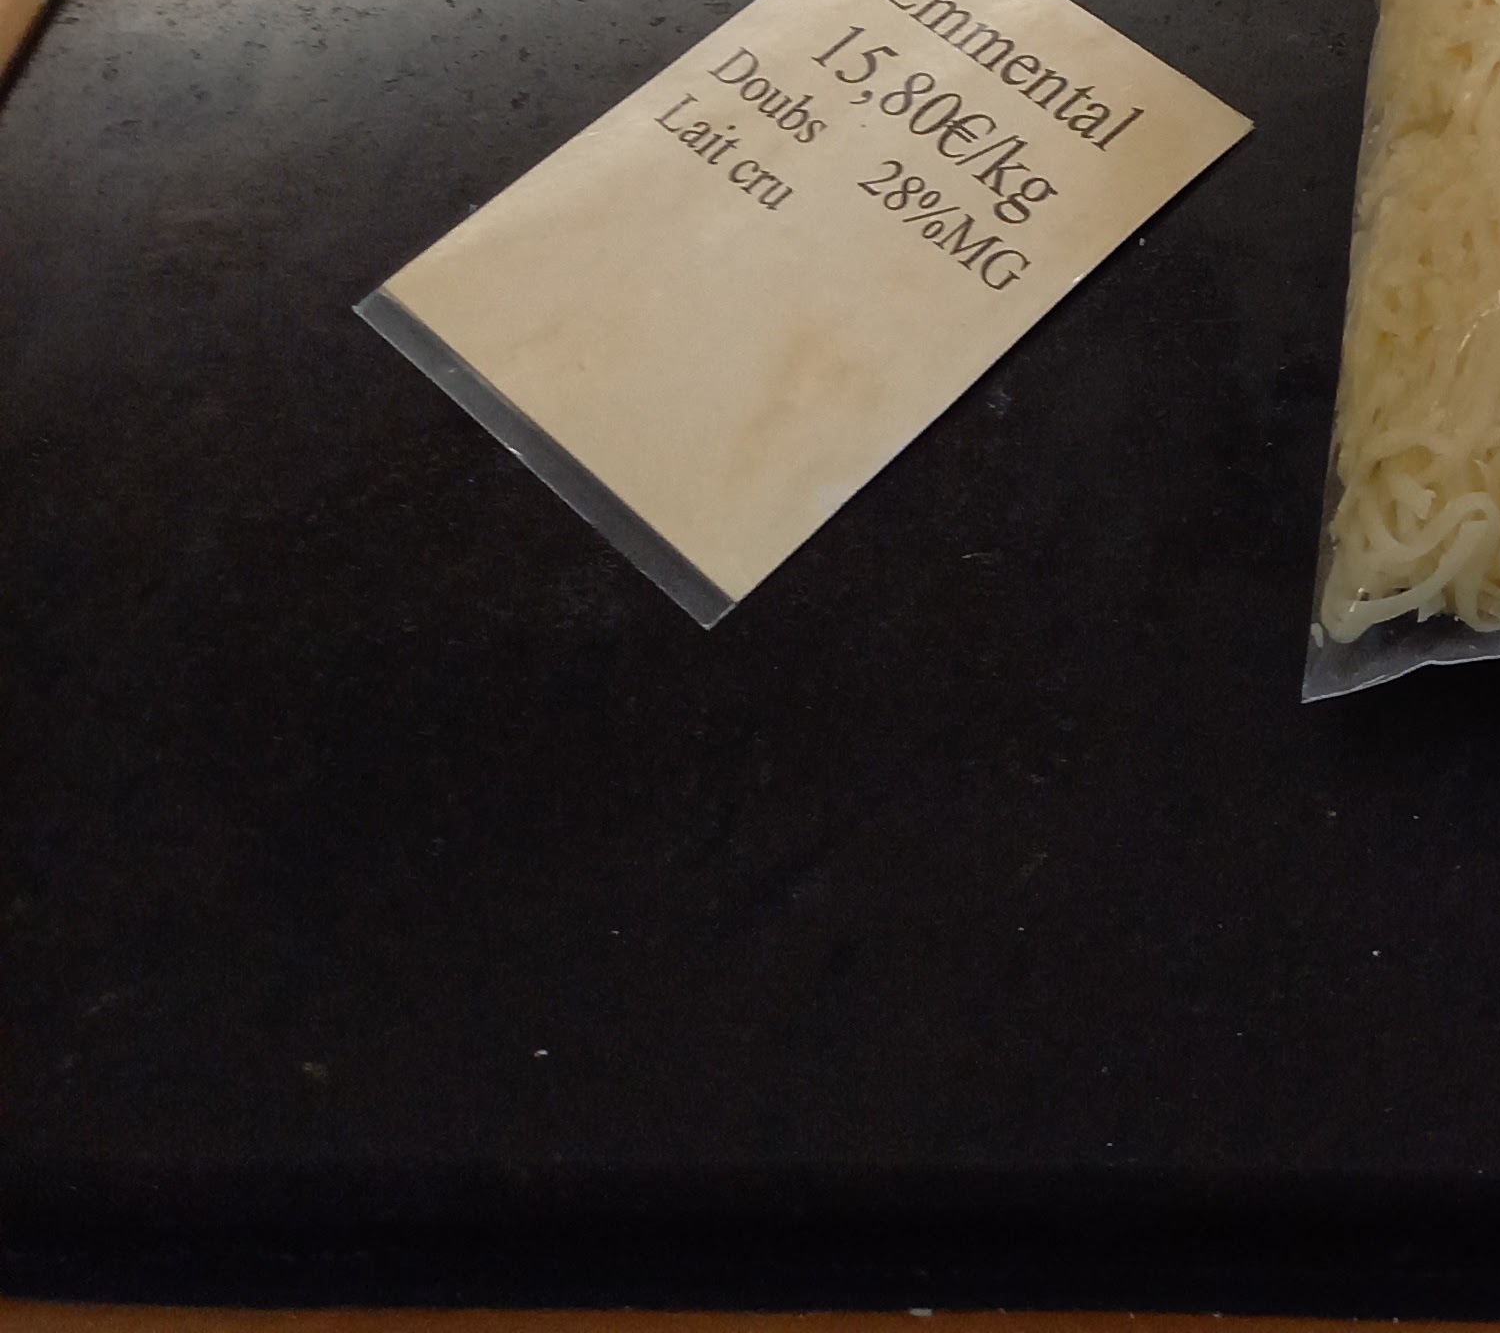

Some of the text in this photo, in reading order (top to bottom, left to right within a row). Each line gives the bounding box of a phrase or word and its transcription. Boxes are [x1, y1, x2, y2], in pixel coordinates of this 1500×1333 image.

[654, 93, 795, 211] Lait cru
[708, 46, 1032, 291] Doubs 28%MG
[811, 25, 1059, 225] 15,80€/kg
